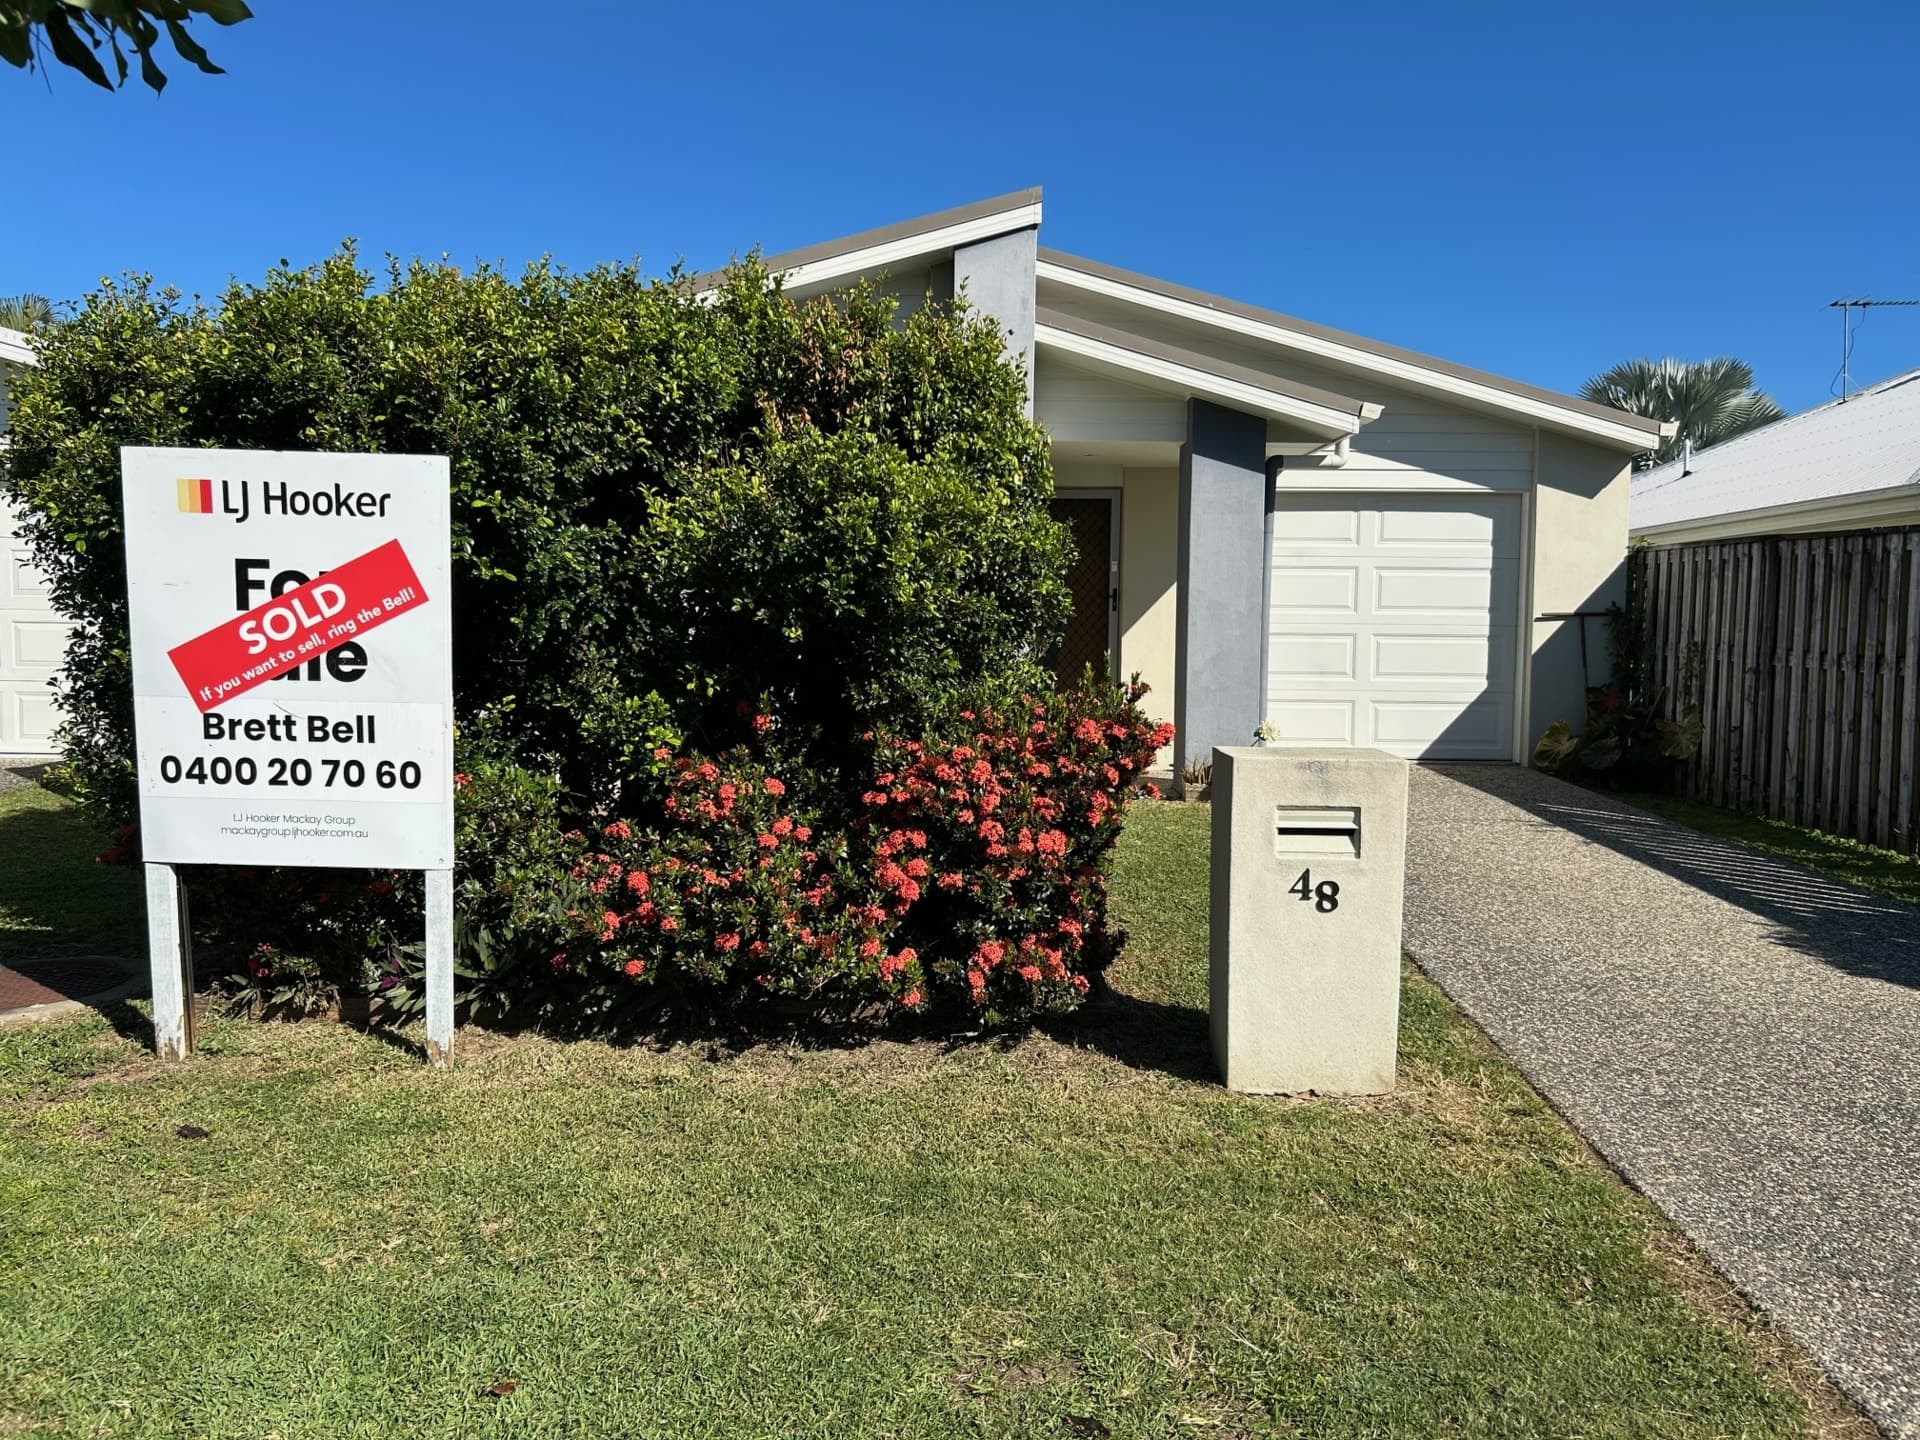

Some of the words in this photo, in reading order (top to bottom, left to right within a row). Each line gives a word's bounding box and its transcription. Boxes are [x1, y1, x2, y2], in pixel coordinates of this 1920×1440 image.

[222, 480, 250, 523] LJ
[263, 481, 391, 517] Hooker
[235, 558, 328, 611] Fo
[239, 584, 346, 655] SOLD
[200, 687, 212, 702] If
[214, 676, 241, 698] you
[242, 657, 278, 681] want
[278, 650, 295, 662] to
[298, 633, 326, 654] sell,
[327, 620, 357, 639] ring
[357, 609, 381, 623] the
[382, 587, 416, 611] Bell!
[203, 712, 297, 742] Brett
[307, 715, 376, 743] Bell
[160, 755, 257, 785] 0400
[268, 758, 312, 786] 20
[321, 760, 365, 788] 70
[376, 760, 421, 789] 60
[233, 813, 243, 822] LJ
[246, 813, 280, 823] Hooker
[283, 814, 321, 826] Mackay
[324, 815, 356, 827] Group
[1288, 868, 1339, 913] 48
